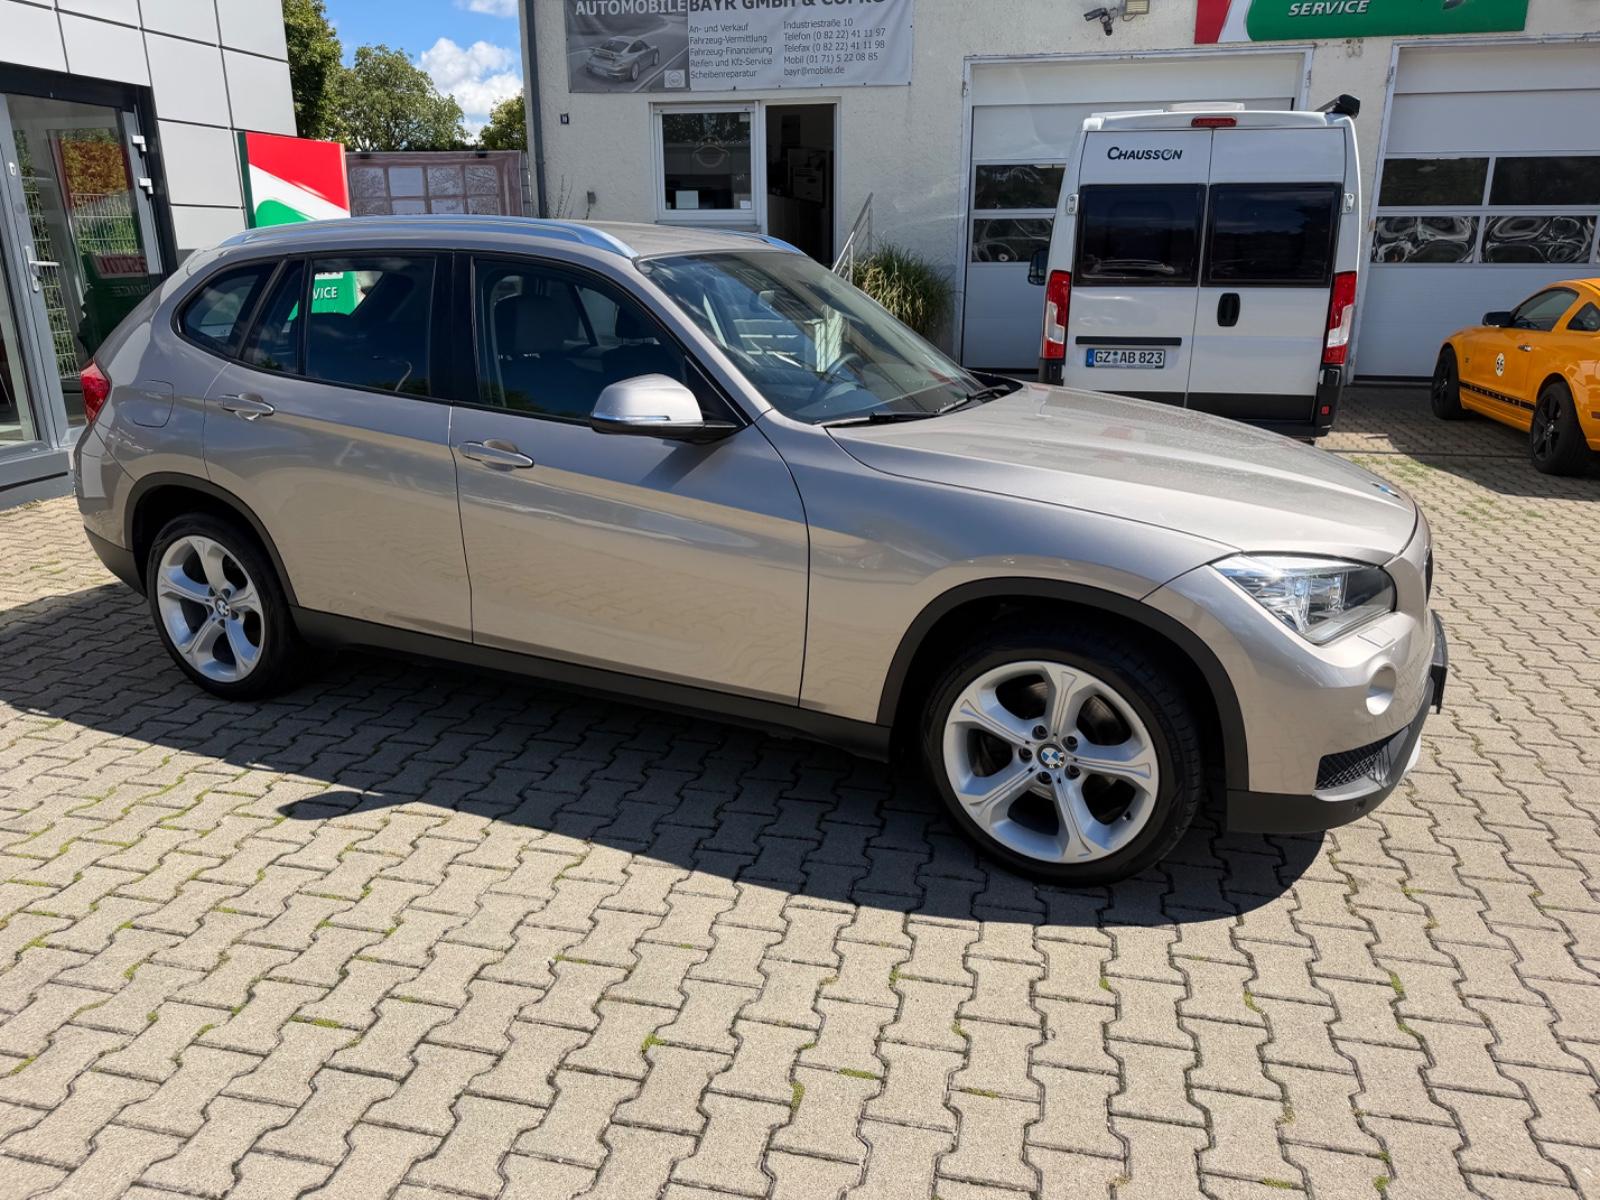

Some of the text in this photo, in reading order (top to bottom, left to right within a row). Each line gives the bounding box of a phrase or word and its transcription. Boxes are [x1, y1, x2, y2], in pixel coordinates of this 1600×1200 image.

[575, 0, 686, 15] AUTOMOBILE
[689, 0, 736, 12] BAYR
[1288, 0, 1370, 16] SERVICE
[689, 22, 749, 33] An- und Verkauf
[784, 18, 853, 29] Industriestraße 10
[689, 34, 768, 45] Fahrzeug-Vermittlung
[784, 28, 886, 40] Telefon (0 82 22) 41 11 97
[689, 46, 773, 57] Fahrzeug-Finanzierung
[784, 40, 885, 53] Telefax (0 82 22) 41 11 98
[690, 57, 773, 67] Reifen und Kfz-Service
[784, 55, 804, 64] Mobil
[806, 54, 818, 65] (01
[821, 54, 834, 64] 71)
[844, 53, 853, 62] 22
[856, 53, 865, 61] 08
[868, 52, 878, 61] 85
[690, 69, 757, 79] Scheibenreparatur
[784, 66, 845, 77] bayr@mobile.de
[1107, 146, 1183, 160] CHAUSSON
[313, 286, 338, 299] VICE
[1095, 351, 1163, 364] GZ AB 823
